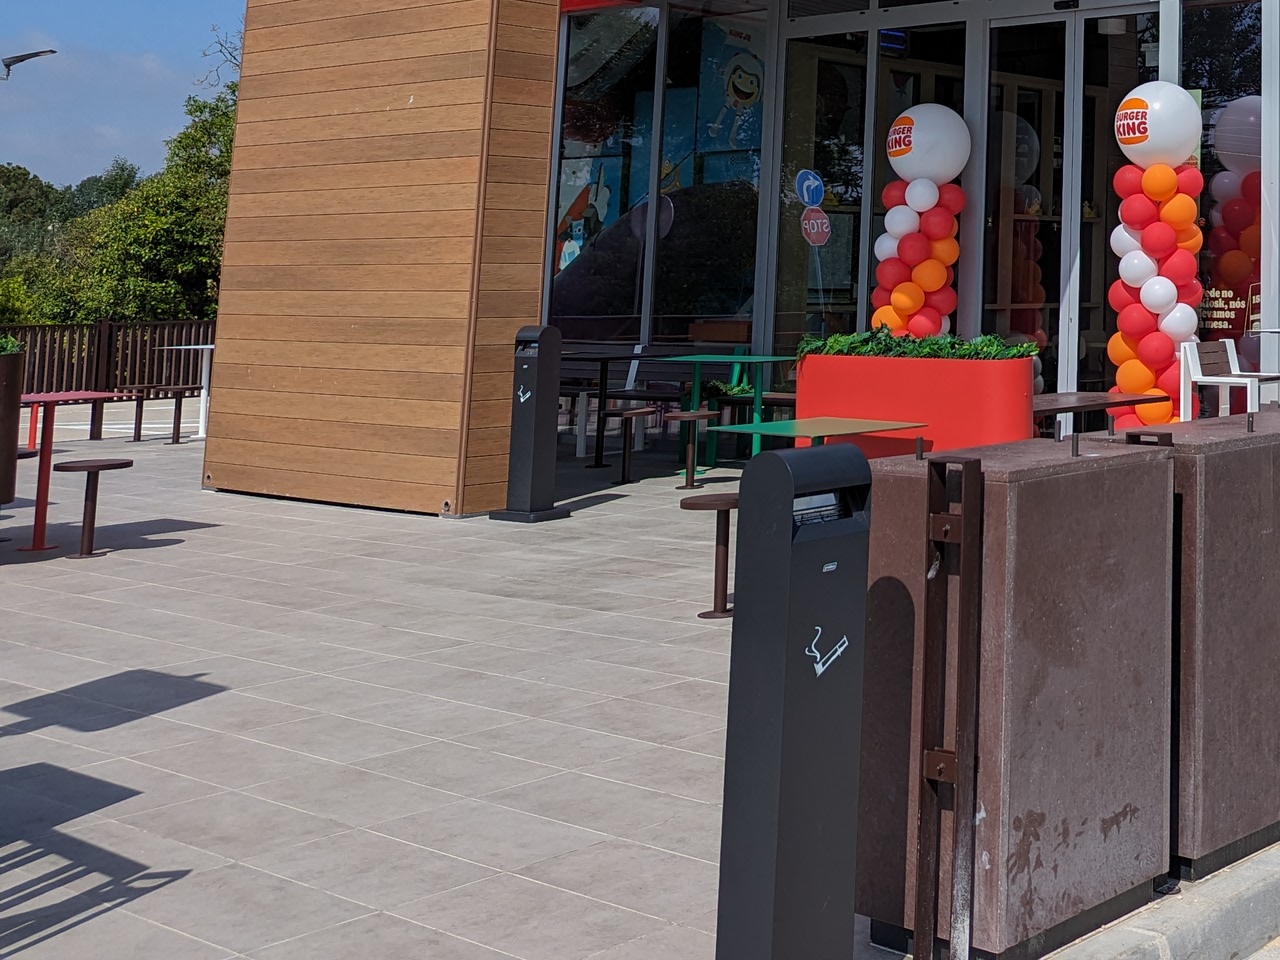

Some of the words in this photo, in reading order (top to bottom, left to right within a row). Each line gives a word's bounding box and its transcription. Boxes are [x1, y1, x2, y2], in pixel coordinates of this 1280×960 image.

[1116, 121, 1148, 137] KING
[1221, 289, 1234, 298] no
[1229, 297, 1246, 309] nós
[1205, 320, 1233, 329] mesa.
